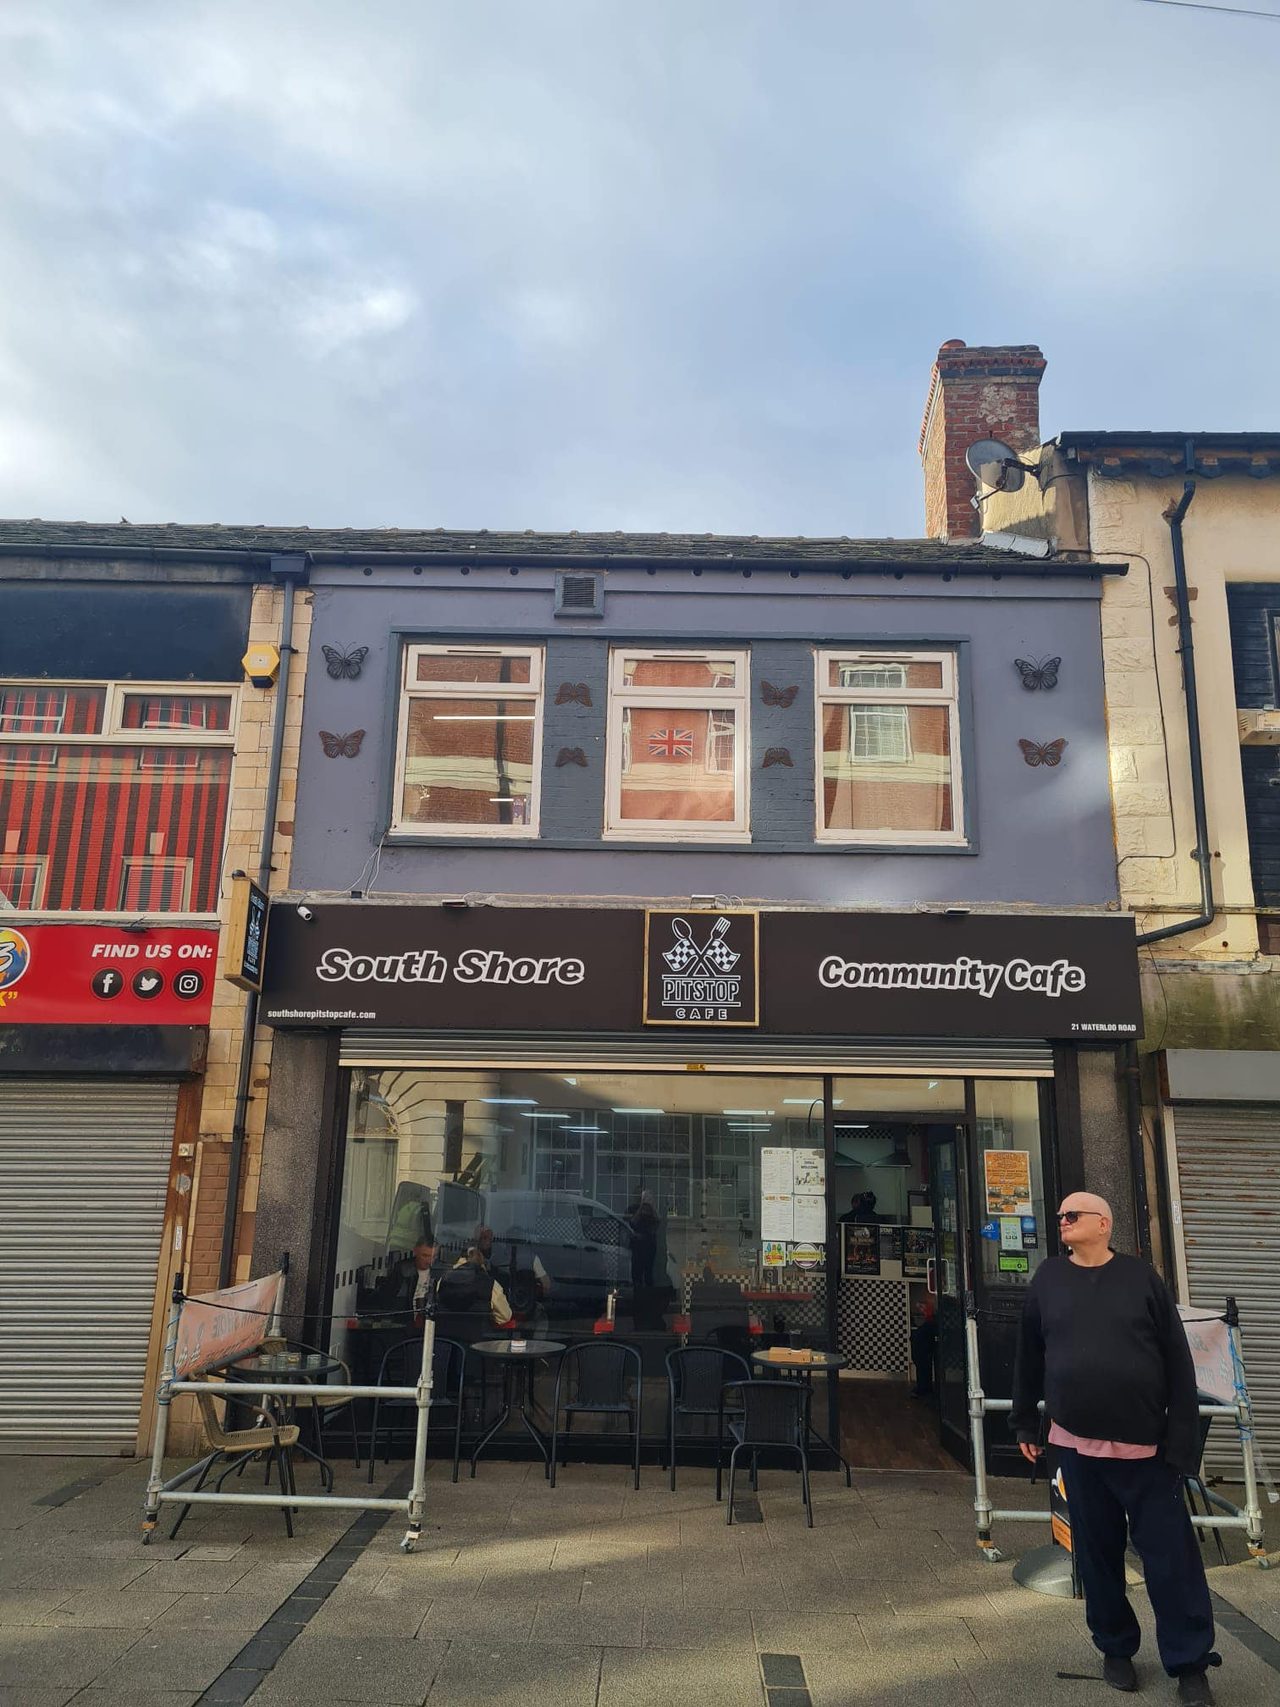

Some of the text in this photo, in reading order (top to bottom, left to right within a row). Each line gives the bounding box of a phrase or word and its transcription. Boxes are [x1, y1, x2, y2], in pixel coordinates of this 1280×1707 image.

[91, 944, 213, 959] FIND US ON:
[316, 948, 585, 985] South Shore
[818, 955, 1087, 998] Community Cafe
[663, 980, 740, 1002] PITSTOP
[267, 1009, 377, 1020] southshorepitstopcafe.com
[675, 1008, 728, 1020] CAFE
[1071, 1023, 1137, 1032] 21 WATERLOO ROAD
